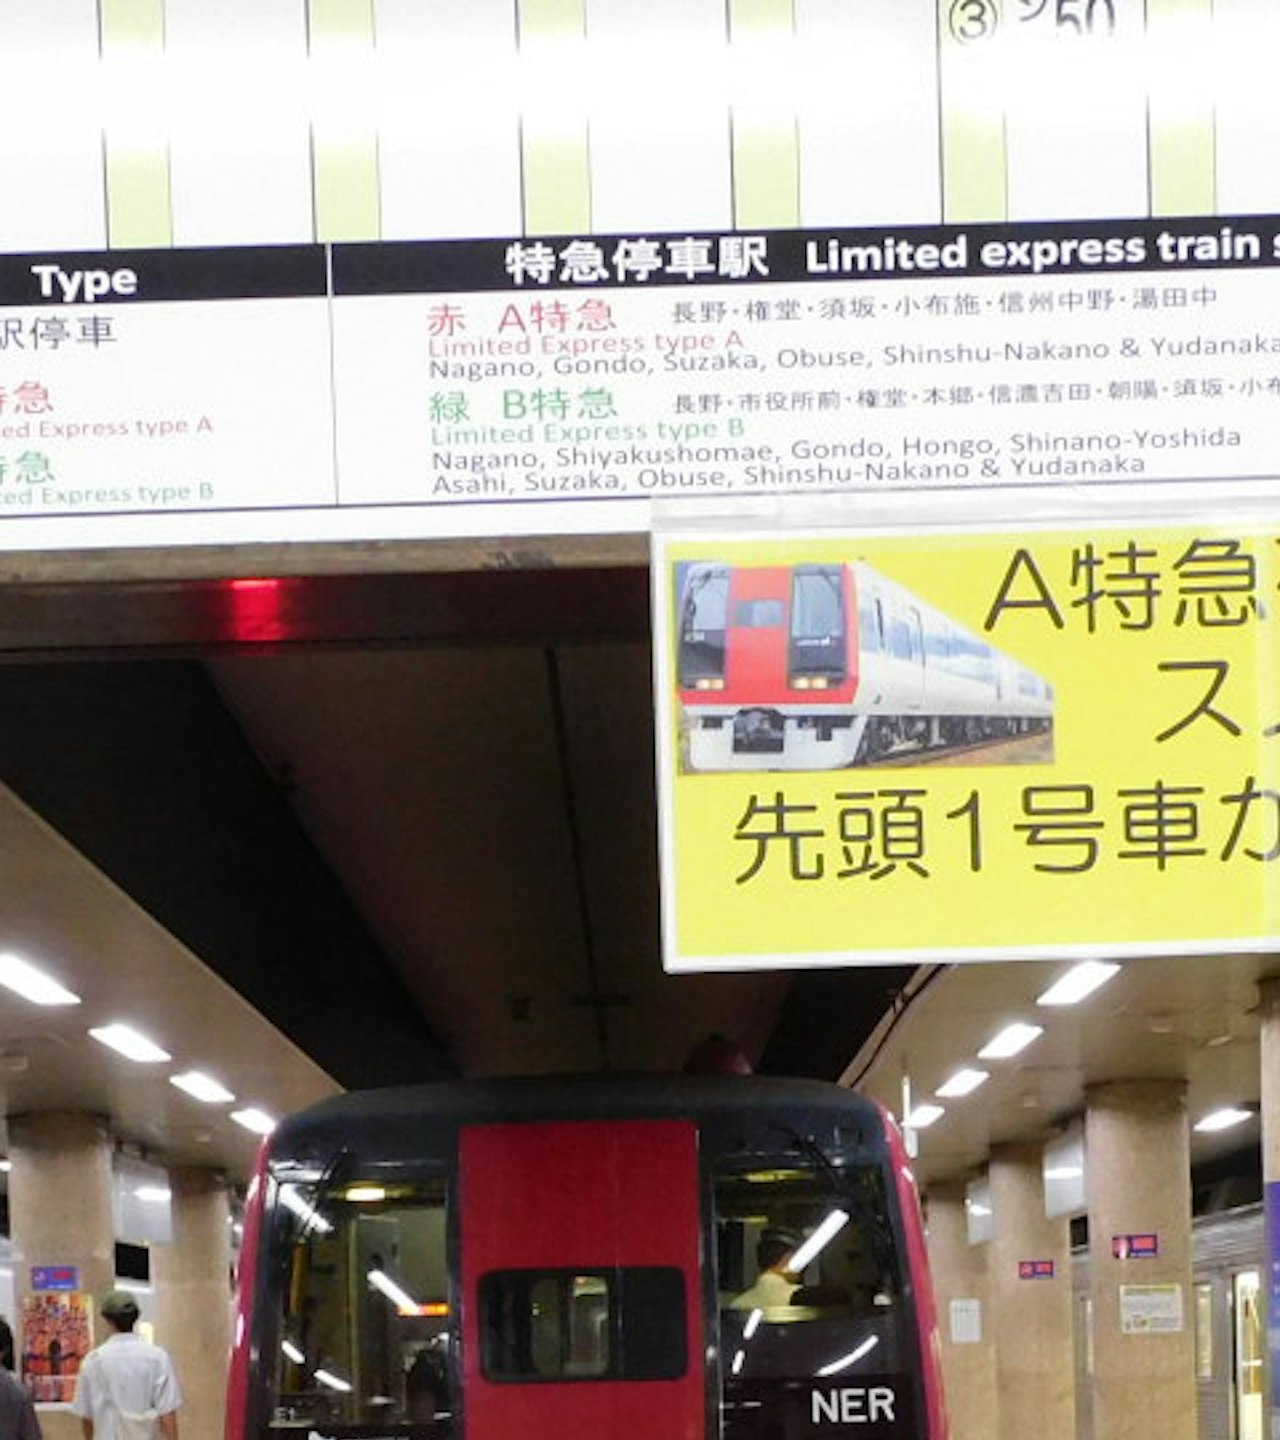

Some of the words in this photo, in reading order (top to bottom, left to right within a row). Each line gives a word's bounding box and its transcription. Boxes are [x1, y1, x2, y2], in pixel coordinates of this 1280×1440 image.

[505, 236, 769, 285] 特急停車駅
[806, 235, 967, 273] Limited
[980, 231, 1146, 272] express
[1157, 228, 1260, 264] train
[32, 265, 138, 302] Type
[427, 305, 466, 336] 赤
[497, 298, 617, 334] A特急
[430, 355, 543, 382] Nagano,
[554, 352, 654, 378] Gondo,
[664, 351, 759, 374] Suzaka,
[777, 348, 874, 371] Obuse,
[883, 339, 1109, 366] Shinshu-Nakano
[1120, 338, 1141, 358] &
[428, 393, 470, 426] 緑
[501, 387, 617, 422] B特急
[812, 1388, 895, 1424] NER
